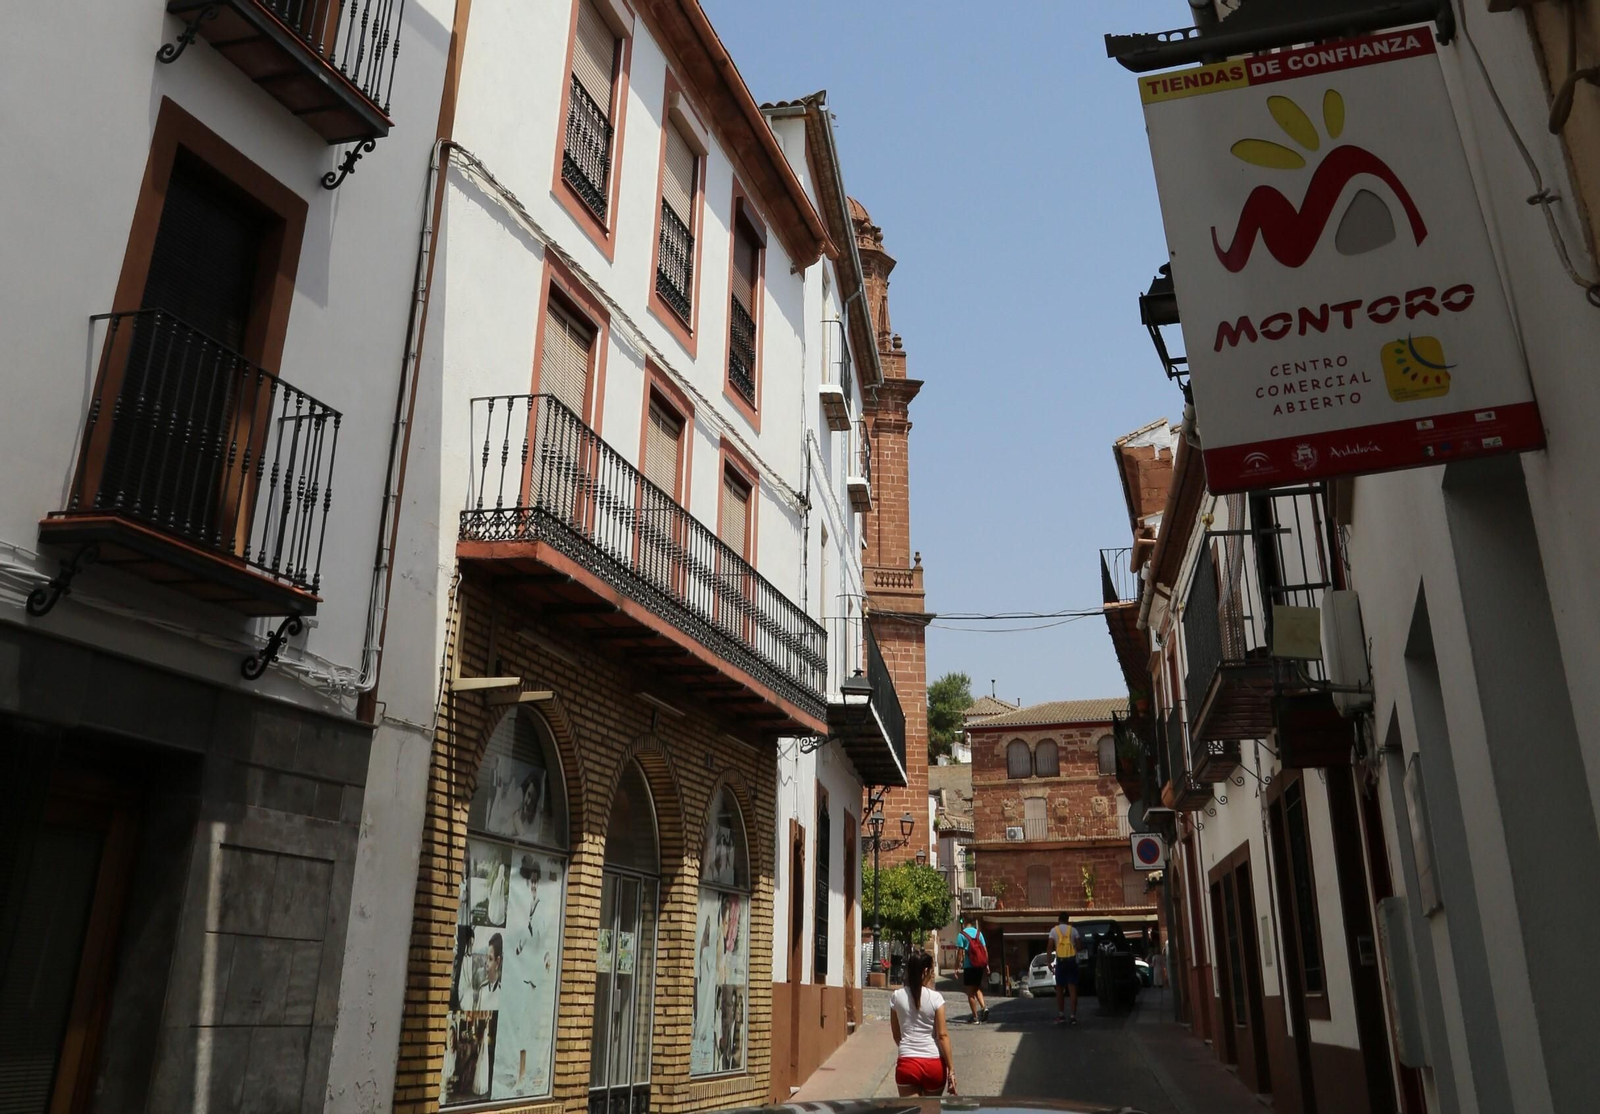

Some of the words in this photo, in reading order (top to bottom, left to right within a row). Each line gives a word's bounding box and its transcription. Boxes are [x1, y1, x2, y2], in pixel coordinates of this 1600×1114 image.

[1147, 66, 1243, 95] TIENDAS
[1250, 58, 1282, 78] DE
[1287, 34, 1421, 69] CONFIANZA
[1213, 284, 1475, 352] MONTORO
[1270, 355, 1348, 377] CENTRO
[1255, 371, 1372, 398] COMERCIAL
[1273, 392, 1361, 415] ABIERTO
